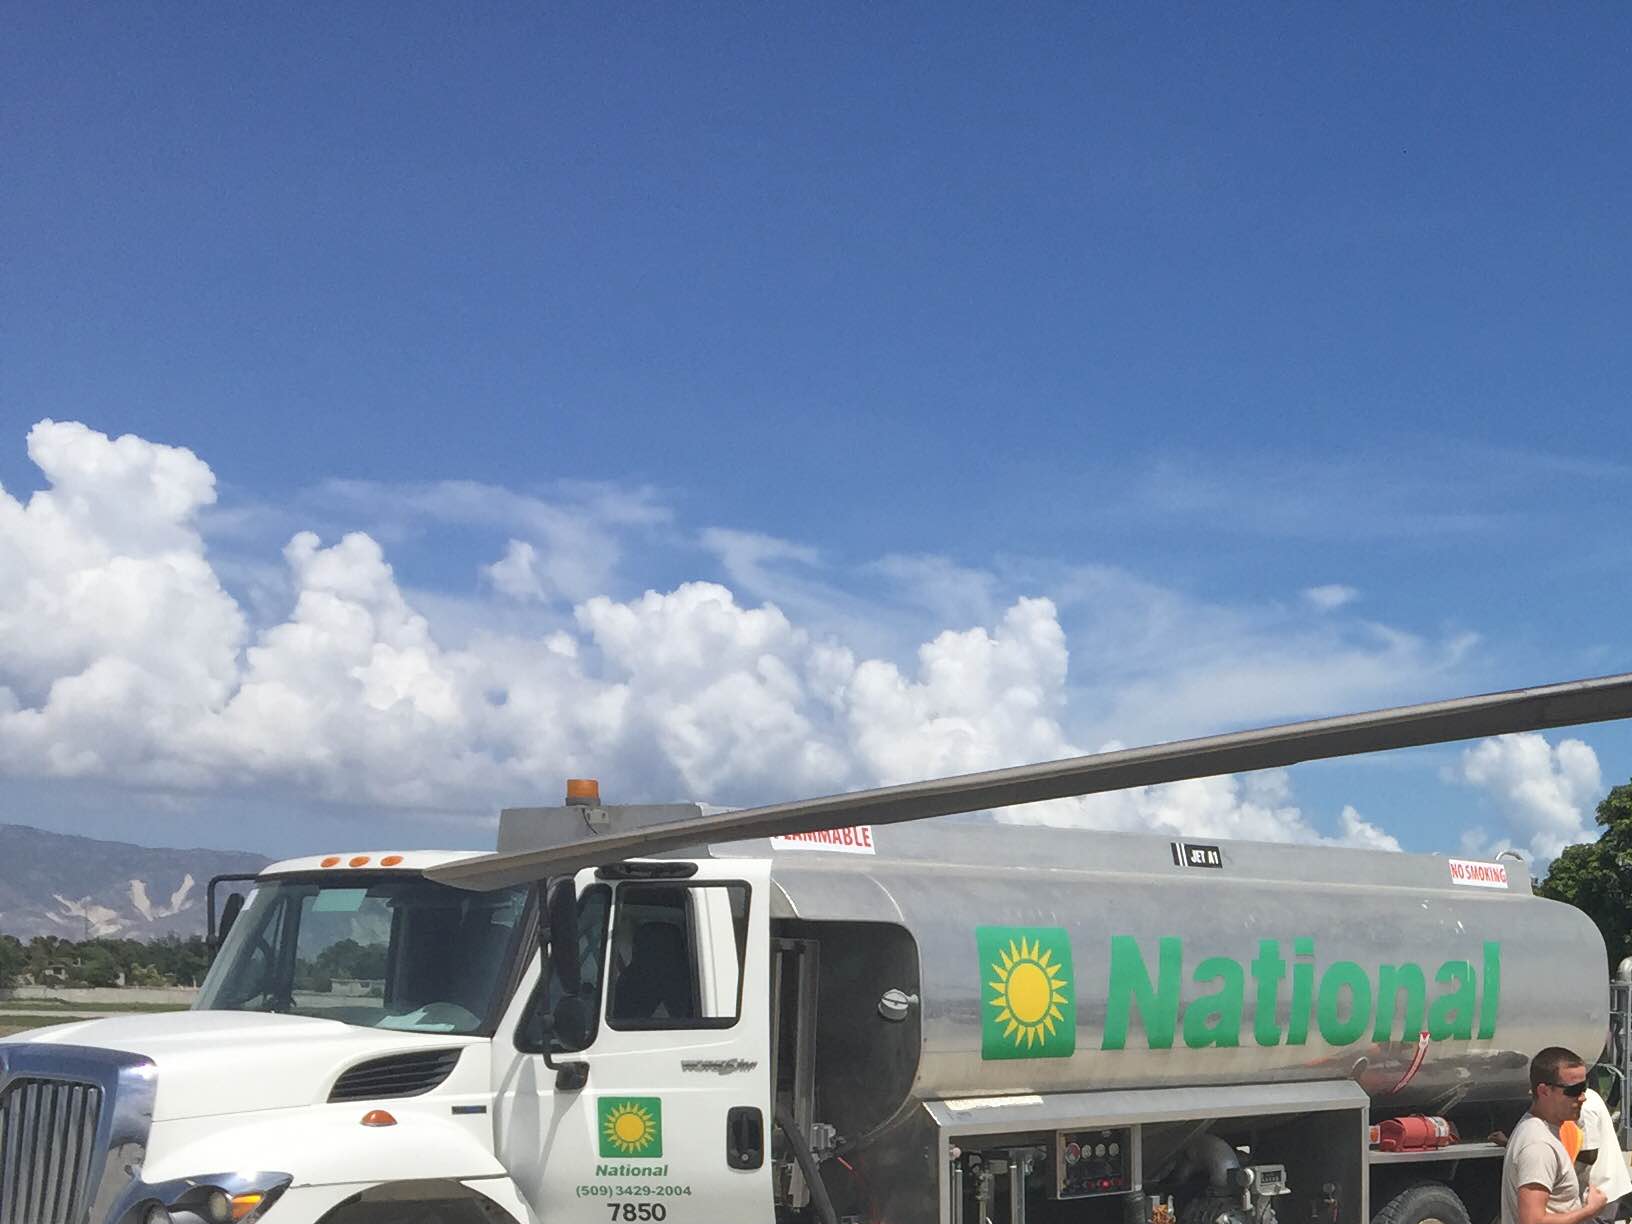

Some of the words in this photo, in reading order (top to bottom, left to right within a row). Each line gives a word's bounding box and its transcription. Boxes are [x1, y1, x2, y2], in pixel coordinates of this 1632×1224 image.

[1190, 849, 1206, 864] JET
[1450, 863, 1465, 879] NO
[1465, 865, 1508, 883] SMOKING
[1101, 935, 1501, 1051] National
[595, 1163, 669, 1177] National
[606, 1202, 667, 1222] 7850
